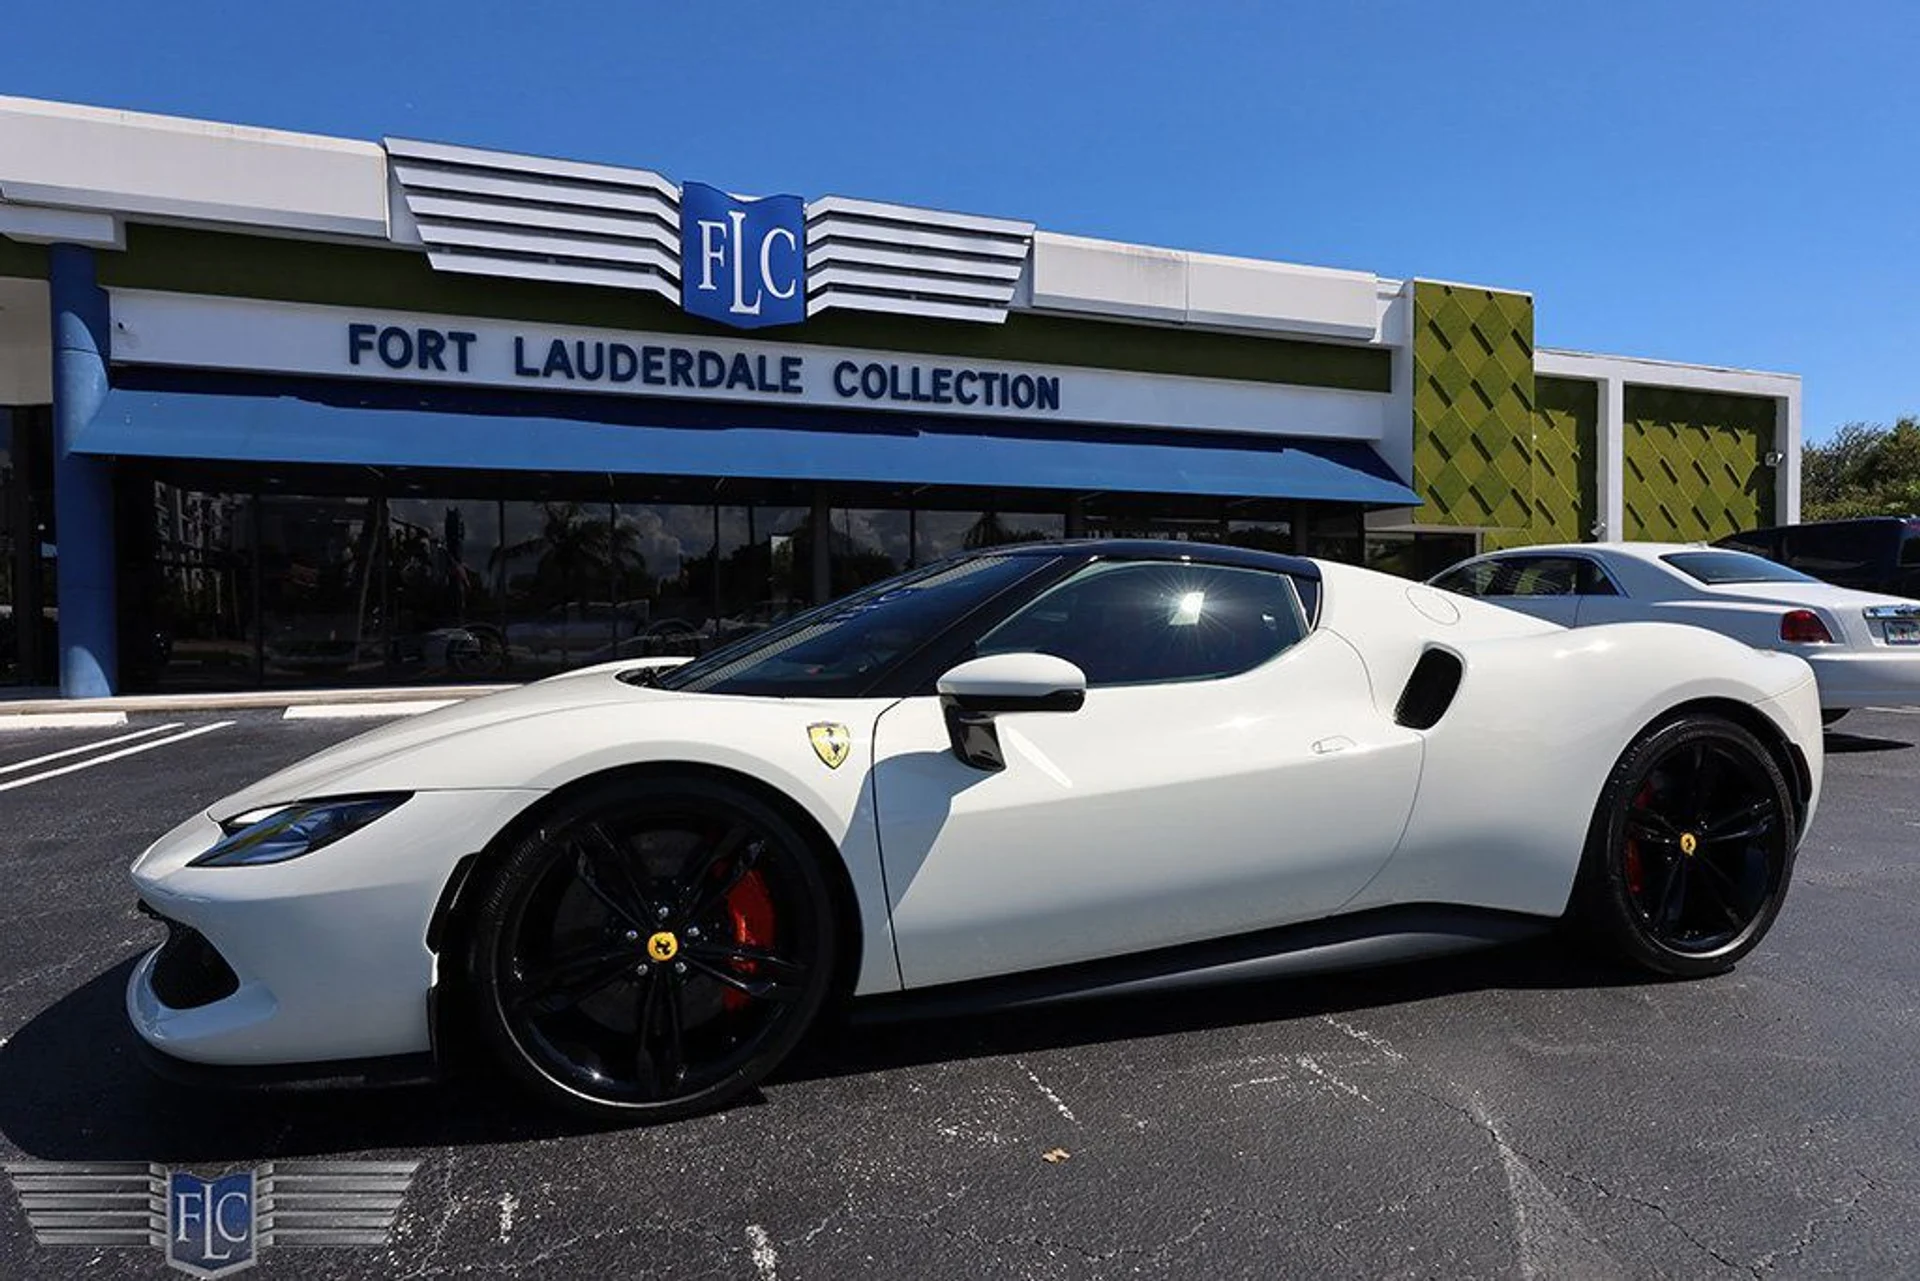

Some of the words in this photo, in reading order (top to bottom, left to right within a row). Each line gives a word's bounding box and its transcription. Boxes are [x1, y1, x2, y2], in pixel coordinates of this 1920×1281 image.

[698, 210, 797, 316] FLC
[348, 322, 478, 374] FORT
[513, 335, 804, 395] LAUDERDALE
[832, 360, 1061, 411] COLLECTION
